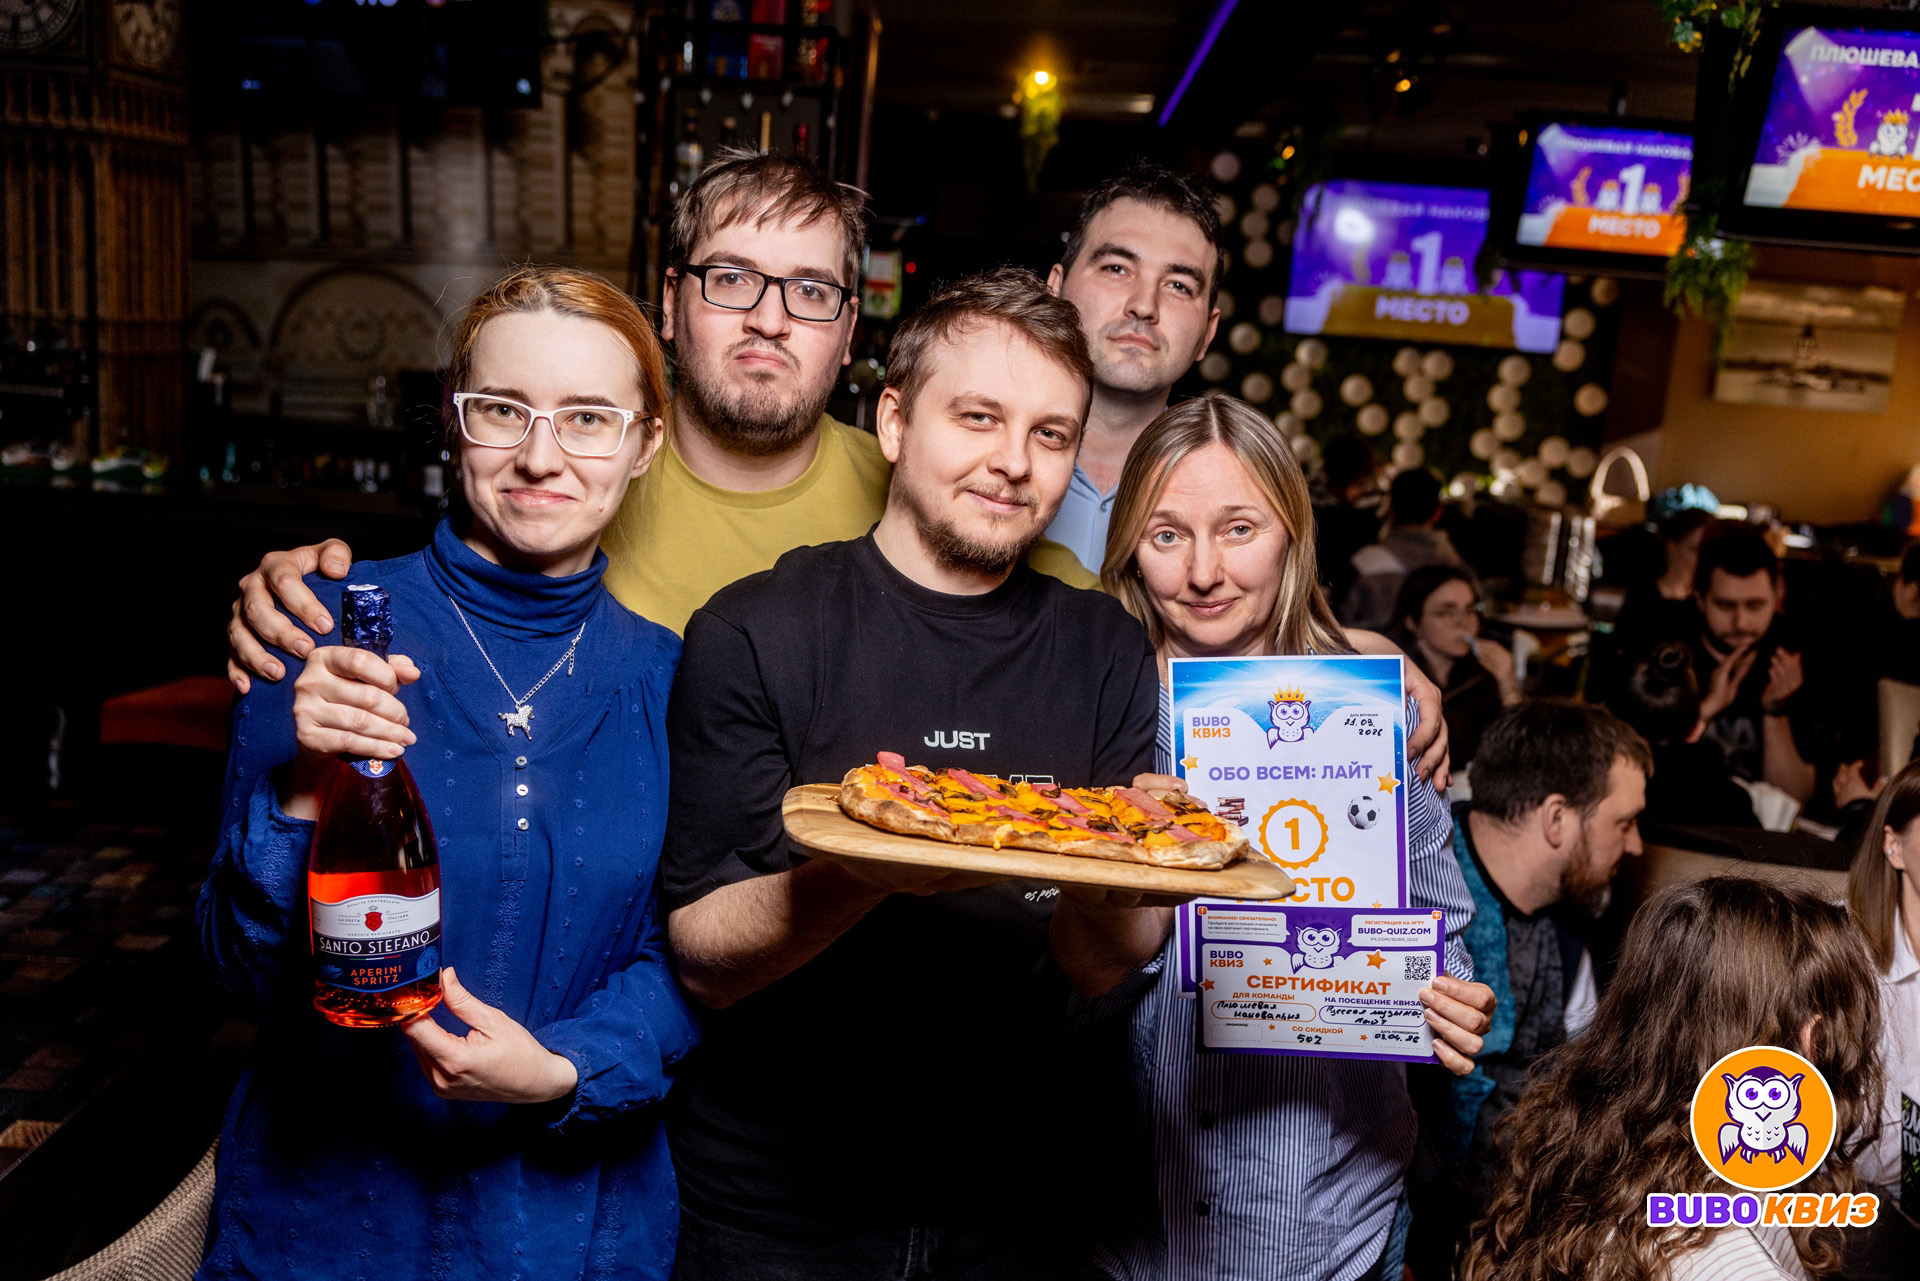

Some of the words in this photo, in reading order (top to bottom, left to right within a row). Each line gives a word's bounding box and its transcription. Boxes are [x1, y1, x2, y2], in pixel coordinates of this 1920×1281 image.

[1810, 45, 1920, 68] ПЛЮШЕВА
[1619, 163, 1646, 214] 1
[1587, 214, 1661, 239] МЕСТО
[1411, 231, 1443, 297] 1
[1374, 295, 1470, 325] МЕСТО
[1192, 716, 1231, 727] BUBO
[924, 730, 991, 750] JUST
[1192, 728, 1231, 739] КВИЗ
[1208, 766, 1250, 781] ОБО
[1256, 765, 1317, 780] ВСЕМ:
[1321, 761, 1373, 780] ЛАЙТ
[1284, 817, 1301, 850] 1
[1358, 927, 1431, 935] BUBO-QUIZ.COM
[319, 937, 362, 954] SANTO
[368, 930, 430, 954] STEFANO
[1210, 950, 1244, 959] BUBO
[1210, 959, 1244, 968] КВИЗ
[350, 965, 402, 977] APERINI
[353, 974, 399, 986] SPRITZ
[1246, 975, 1391, 996] СЕРТИФИКАТ
[1338, 997, 1391, 1006] ПОСЕЩЕНИЕ
[1305, 1026, 1343, 1034] СКИДКОЙ
